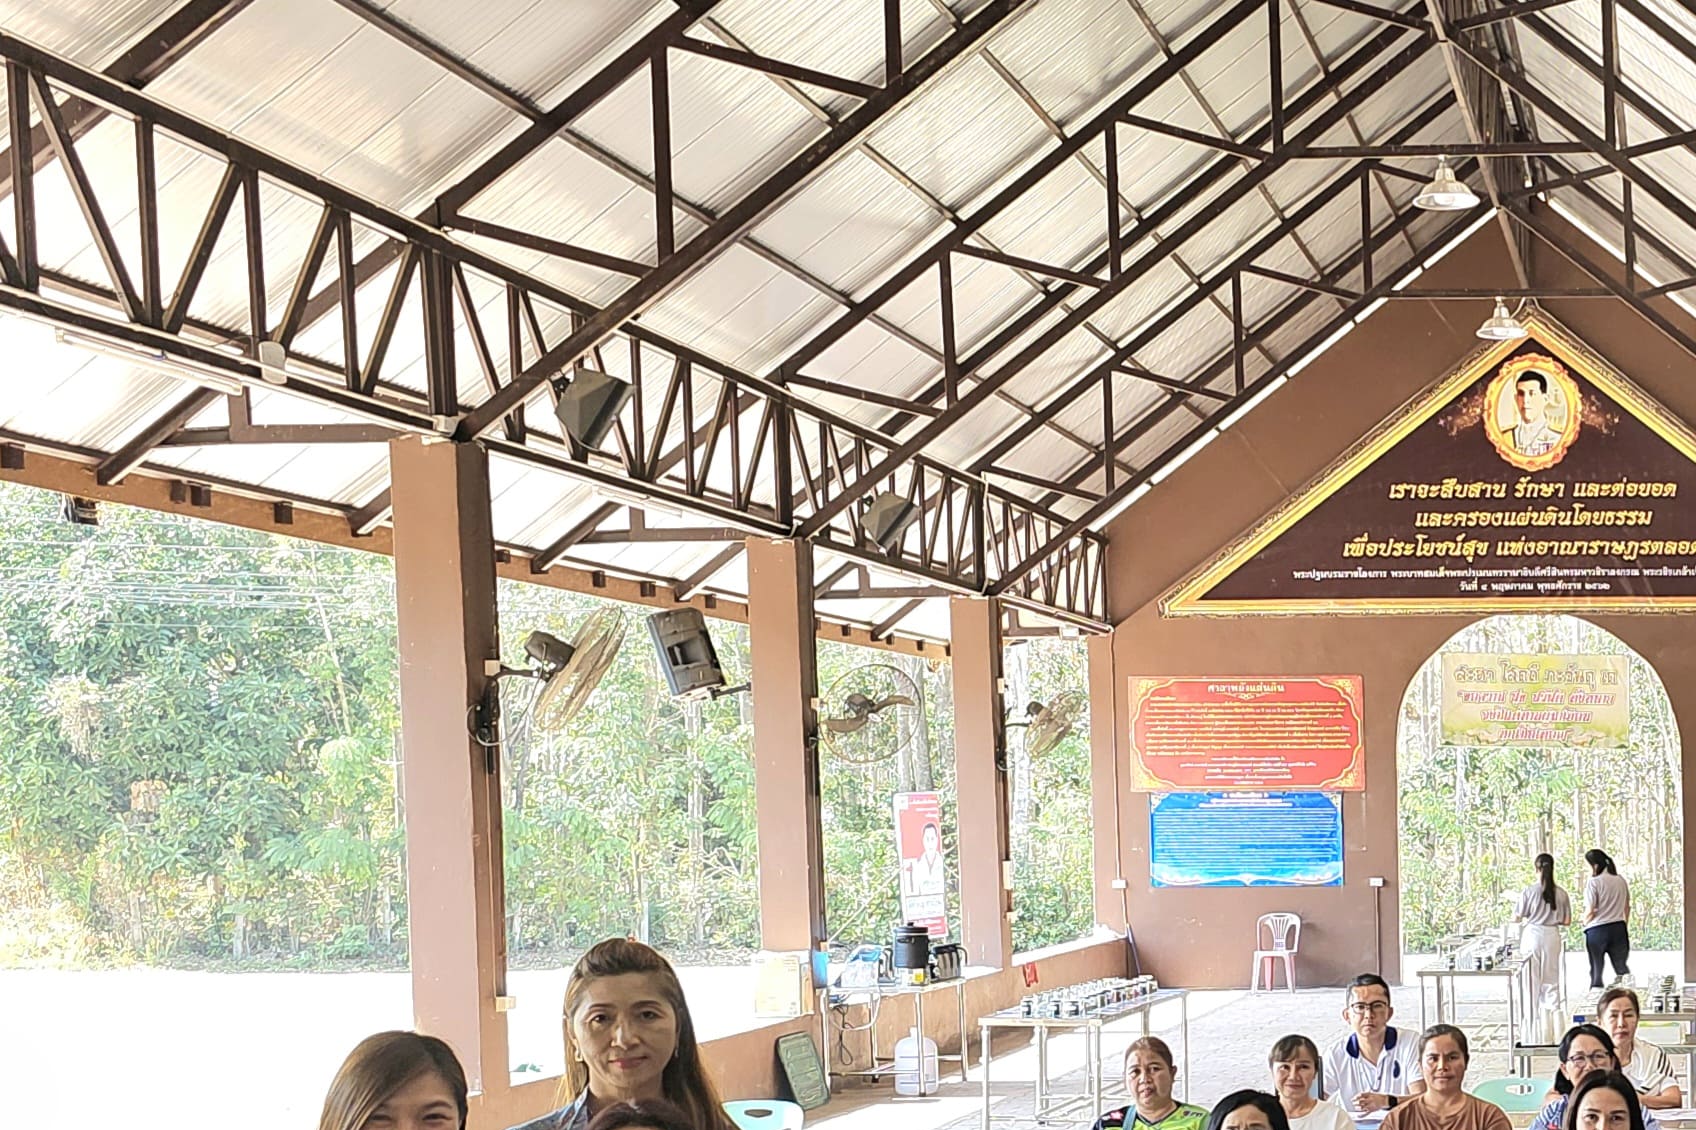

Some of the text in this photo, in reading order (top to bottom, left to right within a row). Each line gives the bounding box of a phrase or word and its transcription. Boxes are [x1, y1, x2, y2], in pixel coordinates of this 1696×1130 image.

[1389, 476, 1677, 499] เราจะสืบสาน รักษา และต่อยอด
[1414, 504, 1652, 527] และครองแผ่นดินโดยธรรม
[1343, 532, 1488, 562] เพื่อประโยชน์สุข
[1460, 577, 1478, 592] วันที่
